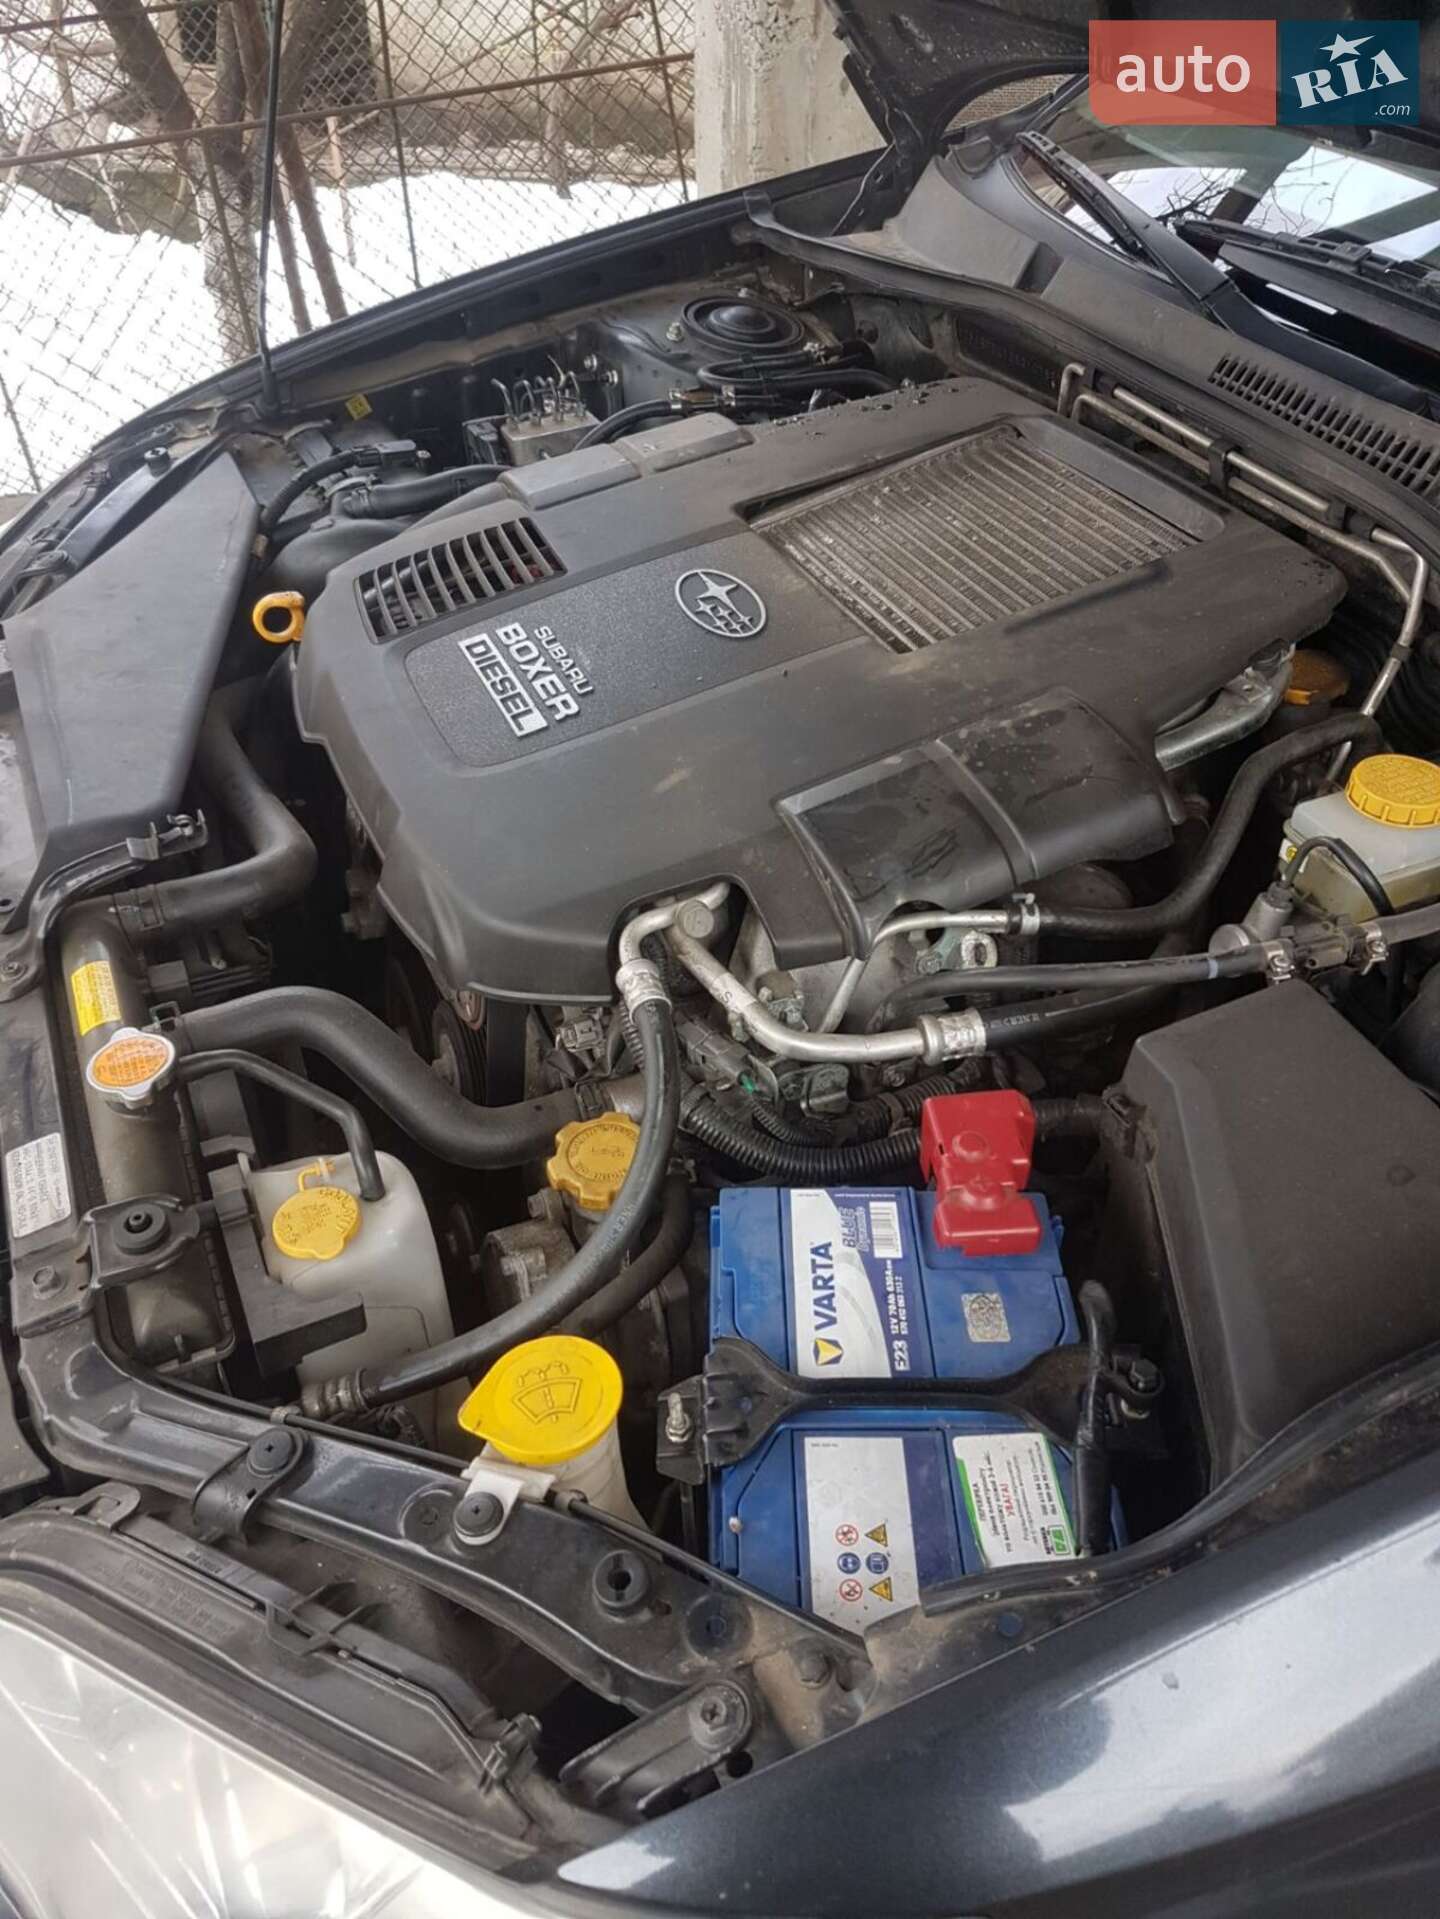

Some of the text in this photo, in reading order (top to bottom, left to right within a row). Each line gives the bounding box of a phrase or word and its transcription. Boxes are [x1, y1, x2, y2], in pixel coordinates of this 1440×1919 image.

[463, 637, 538, 733] DIESEL
[495, 622, 580, 721] BOXER
[534, 625, 594, 695] SUBARU
[838, 1206, 856, 1249] BLUE
[810, 1241, 838, 1331] VARTA
[887, 1293, 897, 1316] 70Ah
[889, 1317, 900, 1335] 12V
[893, 1340, 911, 1371] E23
